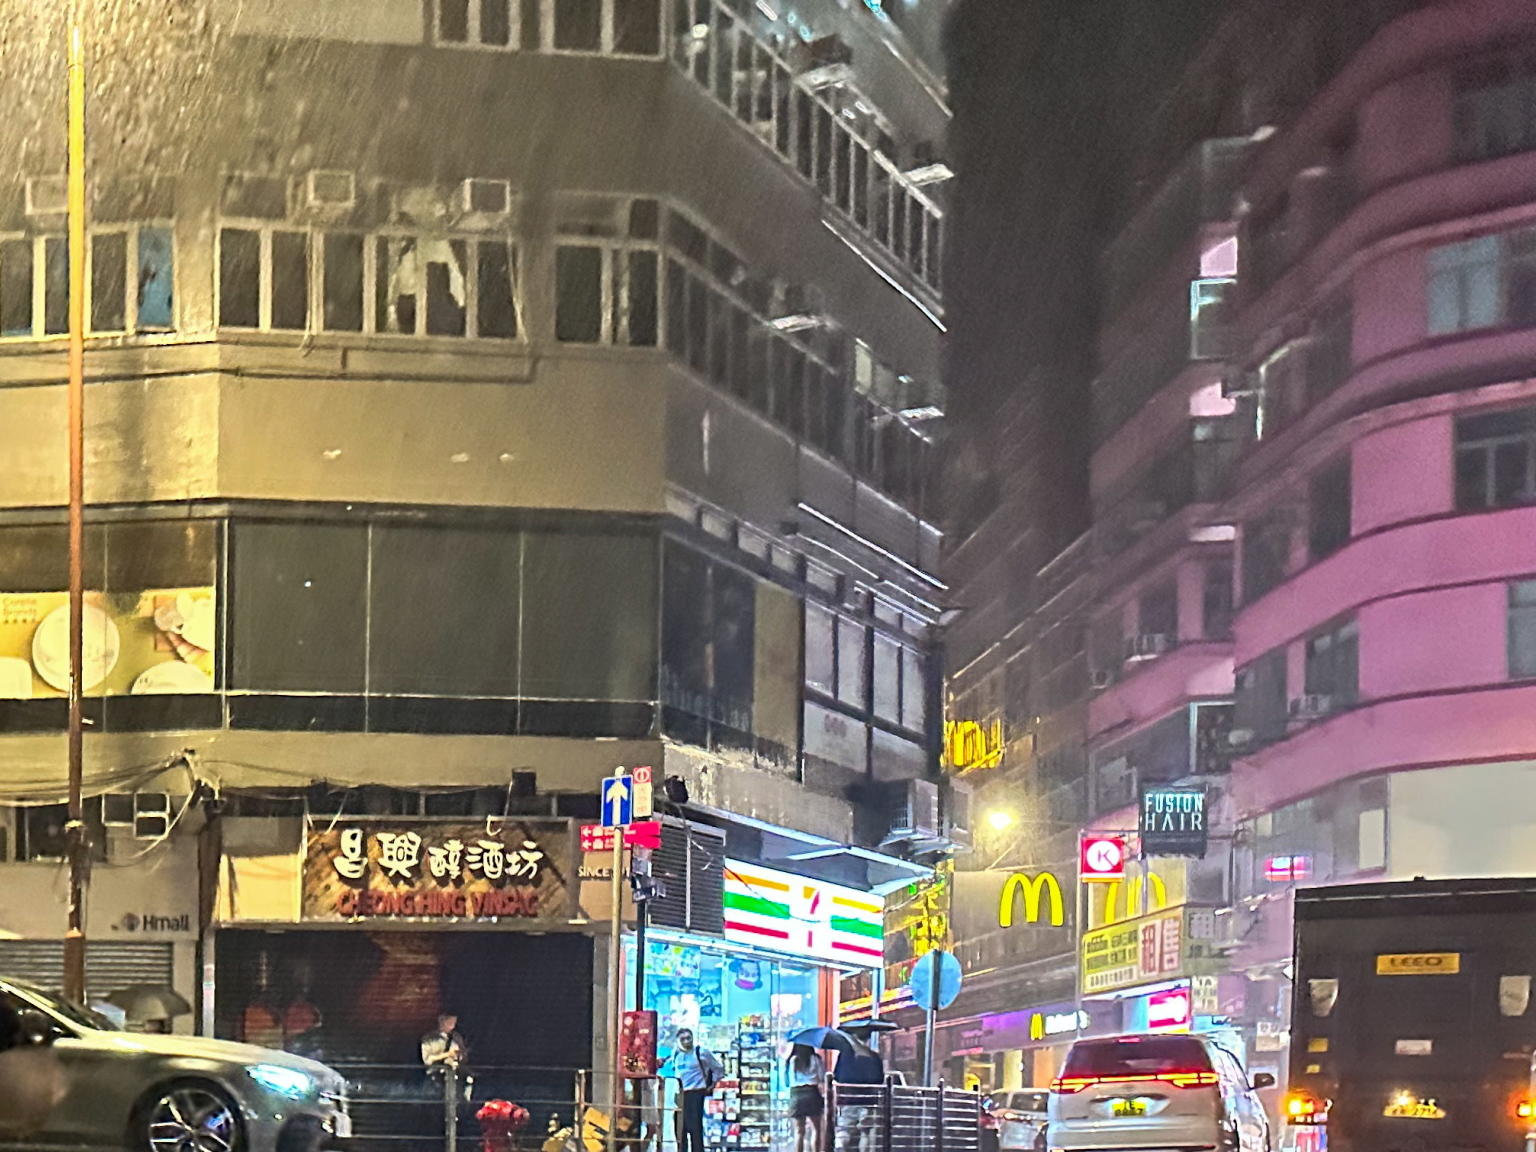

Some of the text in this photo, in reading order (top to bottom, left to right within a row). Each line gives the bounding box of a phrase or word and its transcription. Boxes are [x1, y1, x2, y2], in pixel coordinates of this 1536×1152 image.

[1145, 793, 1204, 812] FUSION
[1145, 813, 1202, 831] HAIR
[333, 829, 543, 879] 昌興醇酒坊
[578, 866, 610, 878] SINCE
[416, 890, 466, 916] HING
